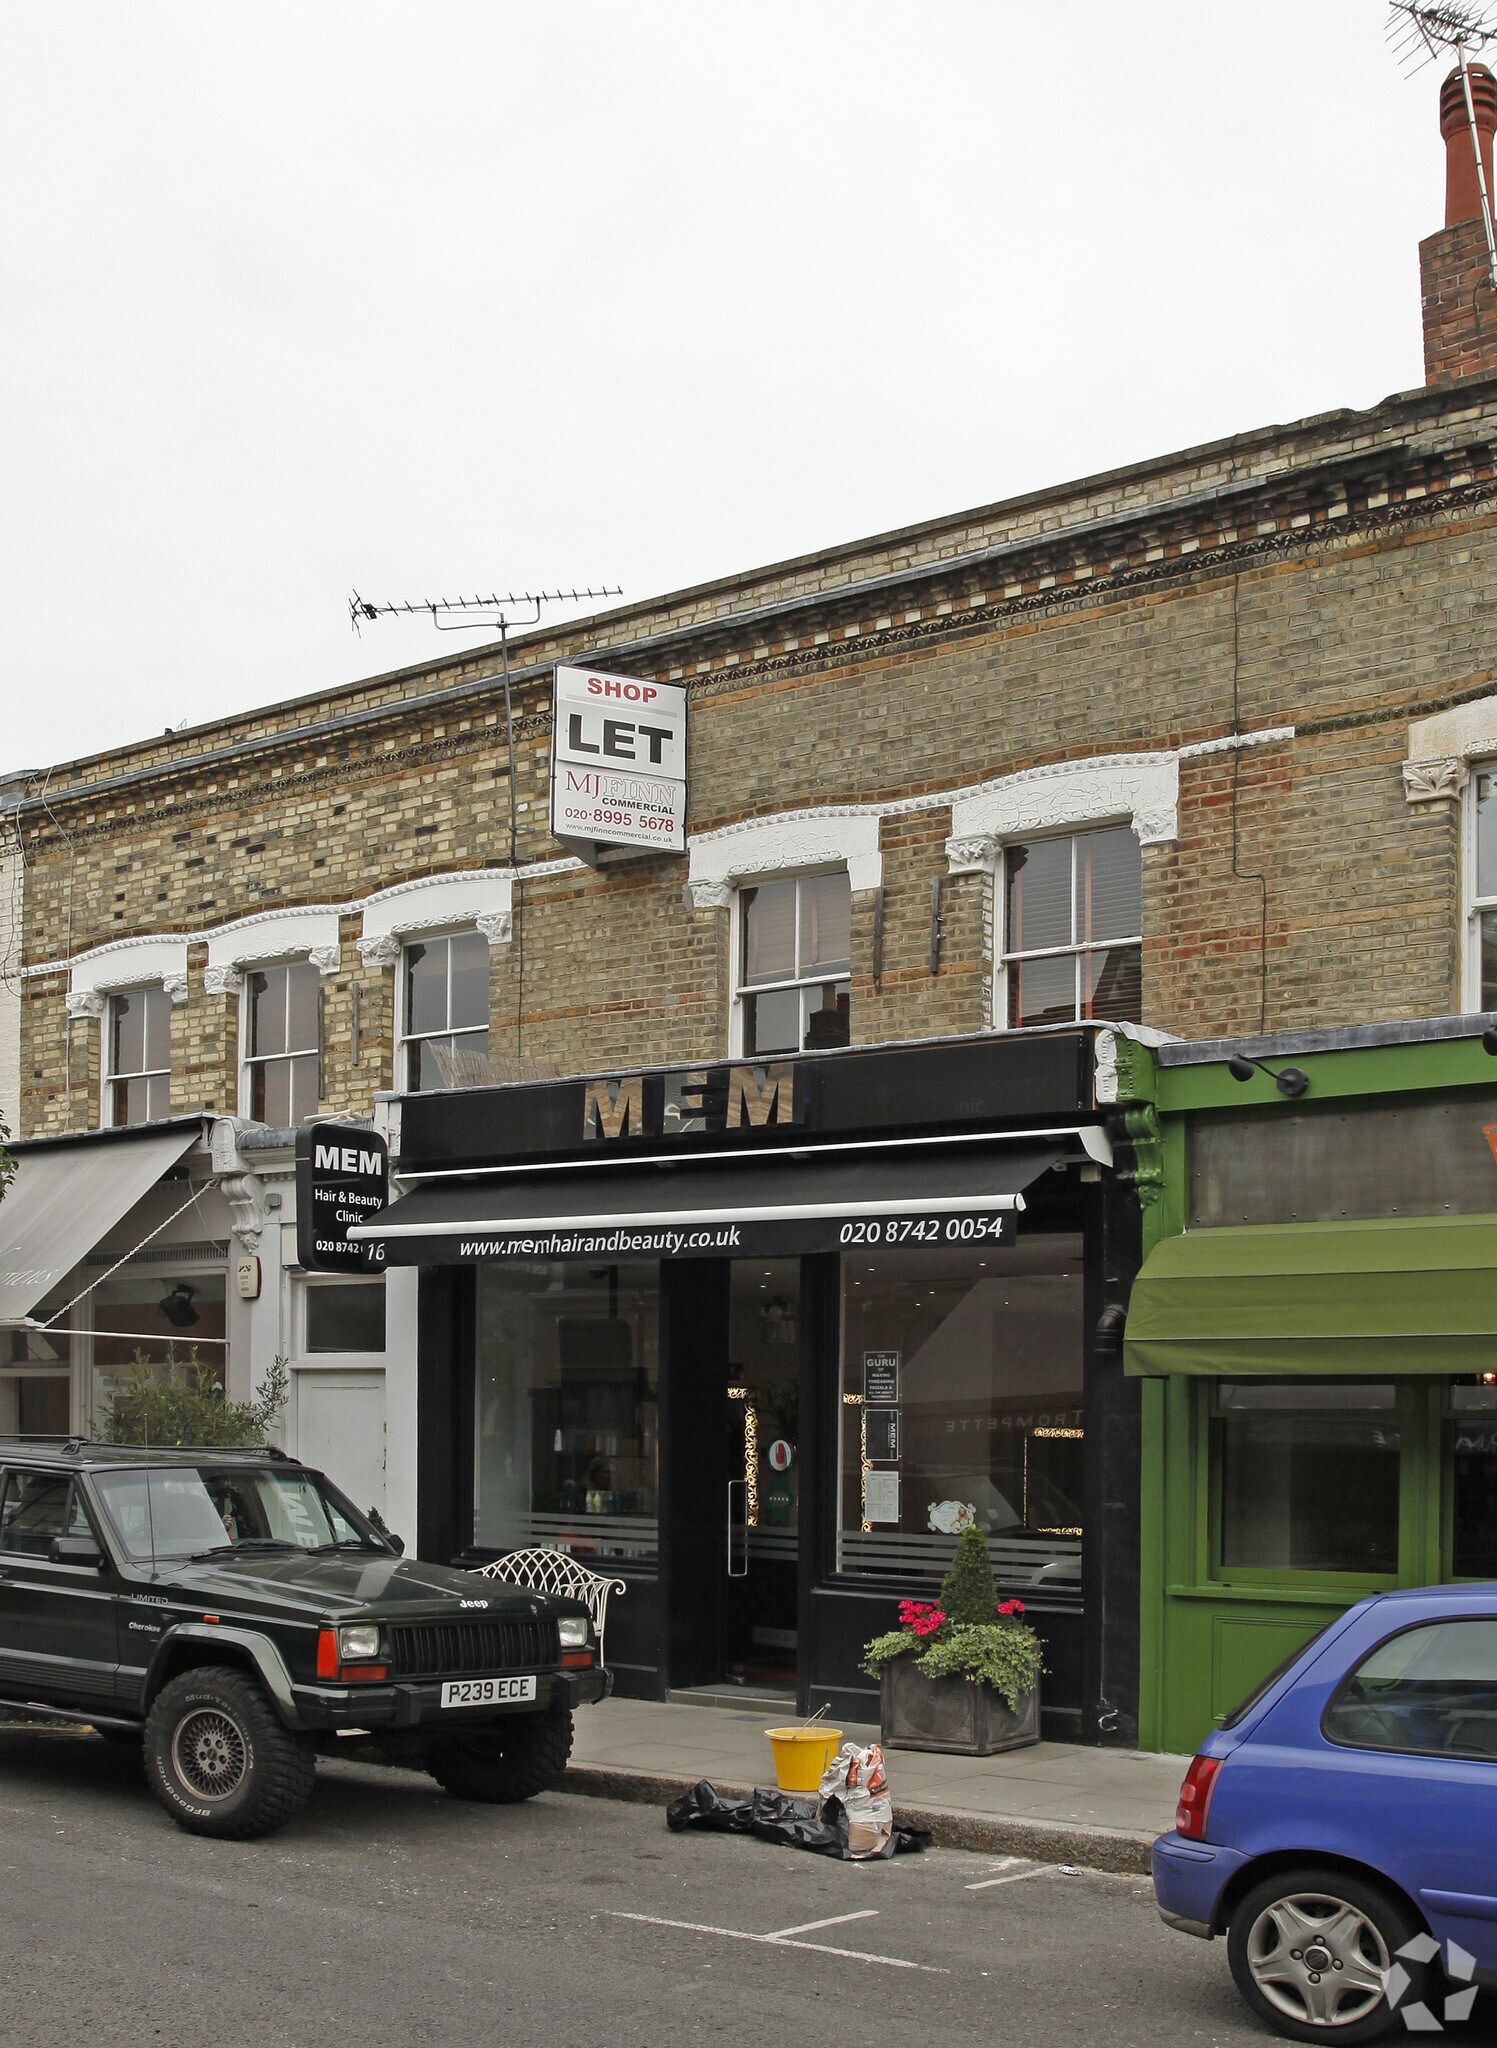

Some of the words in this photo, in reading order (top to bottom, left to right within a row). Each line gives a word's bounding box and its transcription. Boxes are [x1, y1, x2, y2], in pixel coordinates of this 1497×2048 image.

[587, 677, 657, 703] SHOP
[568, 713, 674, 764] LET
[602, 797, 675, 815] COMMERCIAL
[565, 822, 674, 844] www.mjfinncommercial.co.uk
[638, 815, 674, 832] 5678
[582, 1063, 795, 1140] MEM
[314, 1144, 382, 1176] MEM
[315, 1188, 336, 1203] Hair
[338, 1191, 347, 1203] &
[348, 1192, 383, 1210] Beauty
[335, 1209, 364, 1223] Clinic
[839, 1222, 881, 1244] 020
[885, 1219, 940, 1243] 8742
[945, 1216, 1003, 1241] 0054
[315, 1239, 335, 1251] 020
[336, 1241, 359, 1253] 8742
[459, 1225, 741, 1256] www.memhairandbeauty.co.uk
[367, 1243, 386, 1261] 16
[866, 1358, 896, 1367] GURU
[131, 1593, 169, 1605] LIMITED
[459, 1599, 489, 1609] Jeep
[128, 1621, 161, 1633] Cherokee
[448, 1681, 494, 1703] P239
[498, 1679, 530, 1699] ECE
